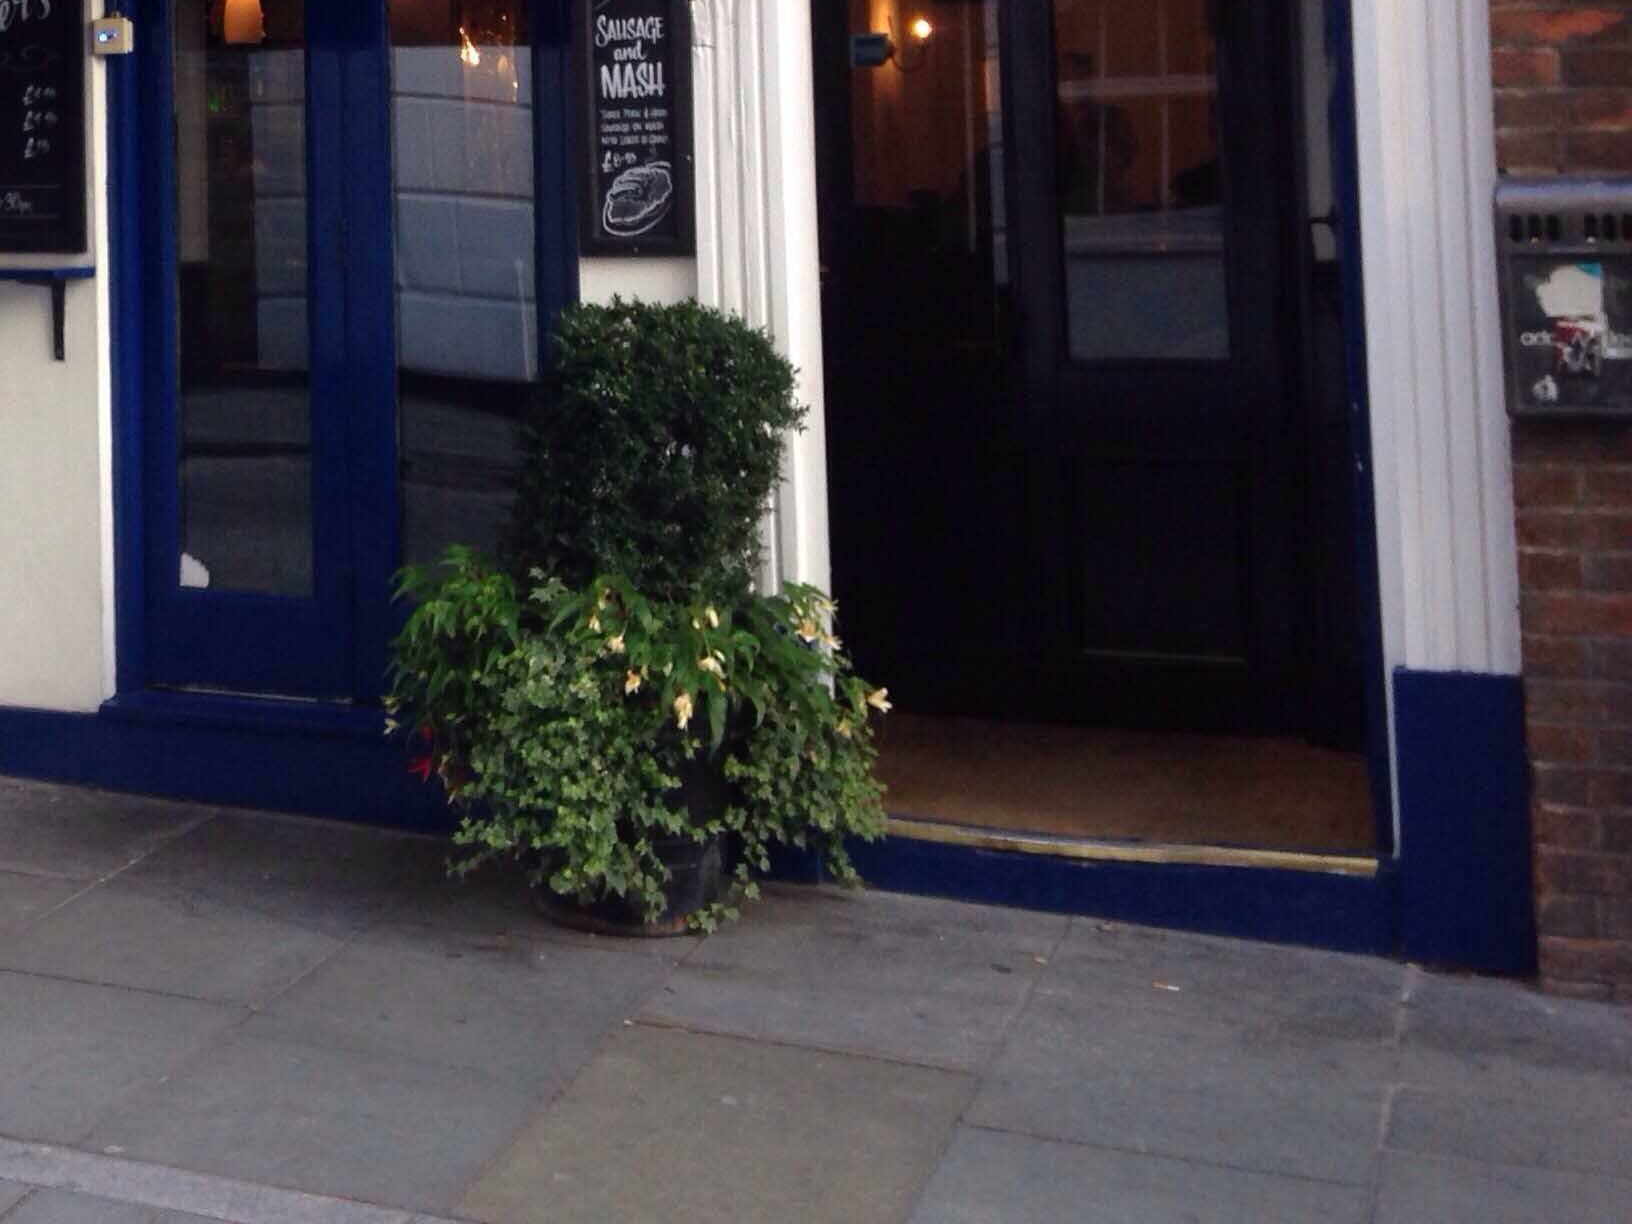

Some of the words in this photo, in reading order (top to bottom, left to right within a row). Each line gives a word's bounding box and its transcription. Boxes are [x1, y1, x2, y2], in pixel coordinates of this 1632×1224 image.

[595, 14, 664, 48] SAUSAGE
[614, 40, 647, 61] and
[600, 61, 665, 99] MASH
